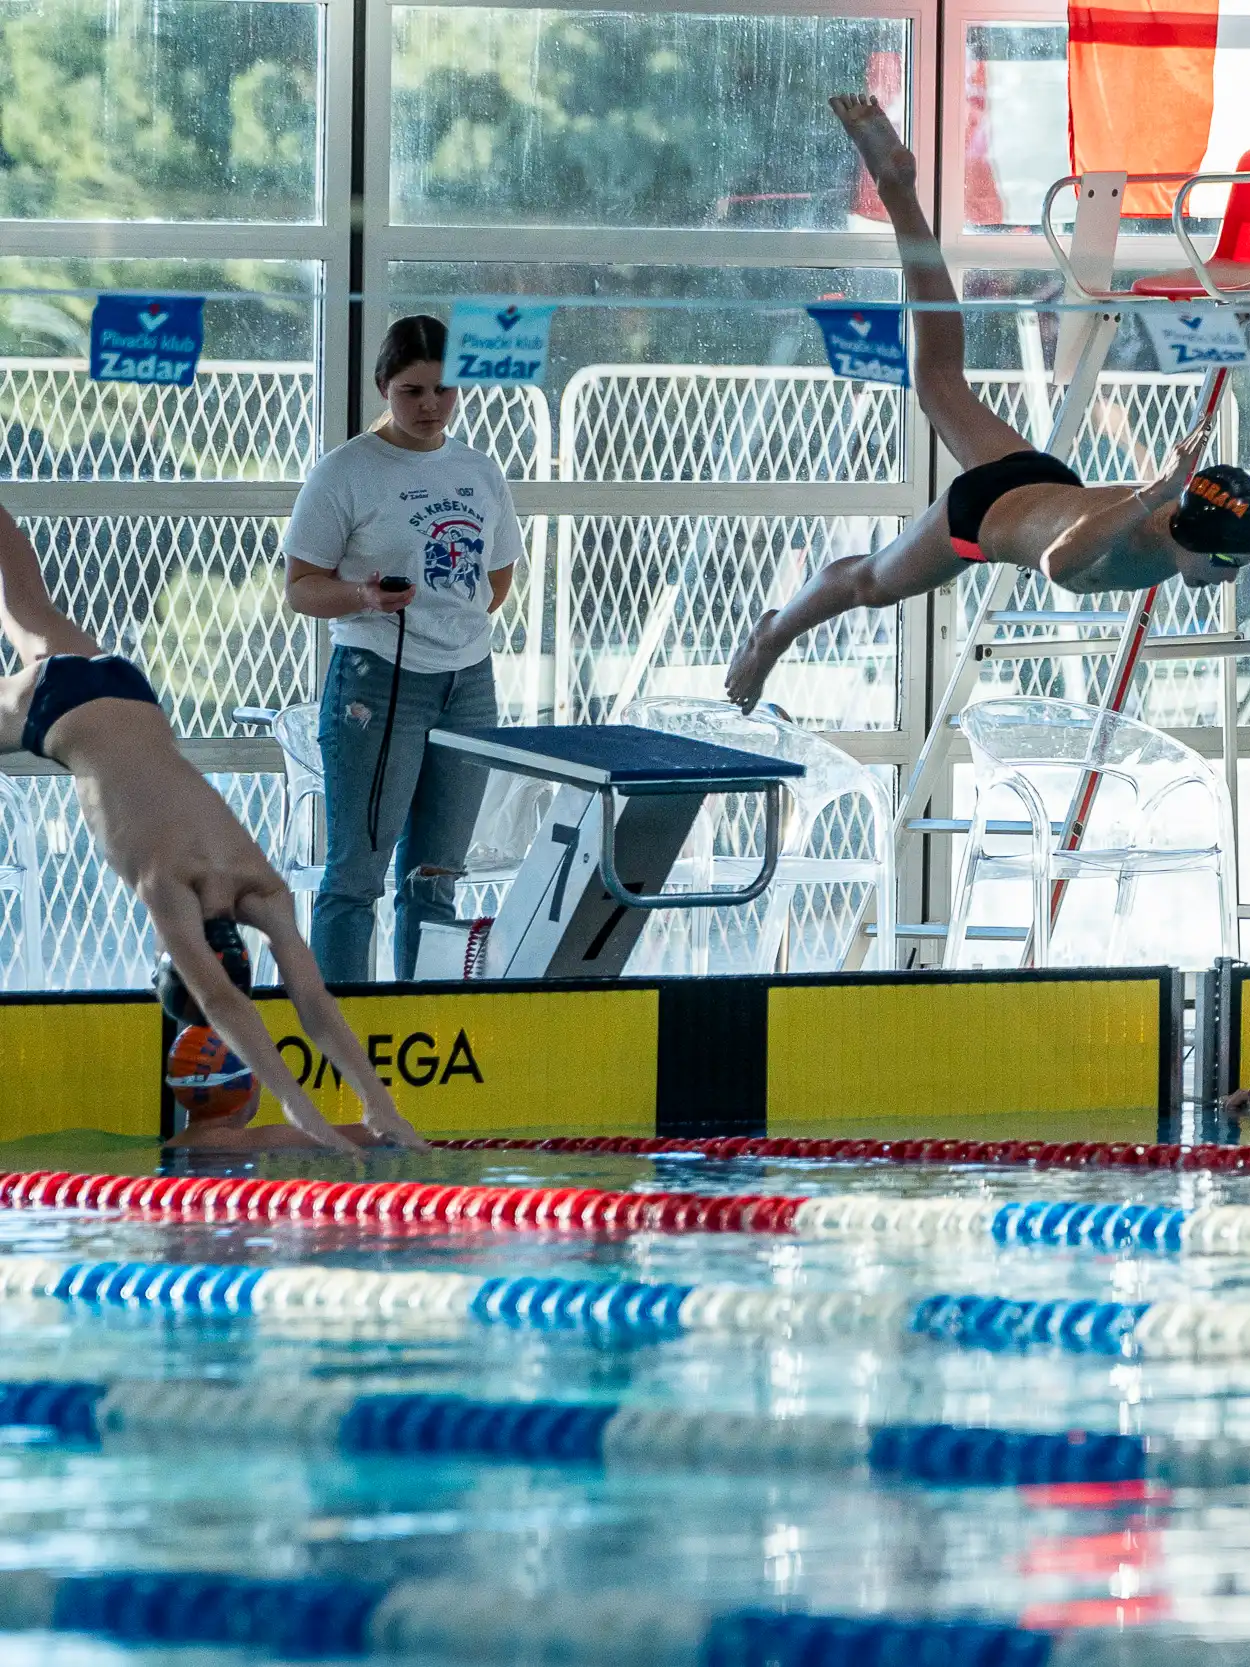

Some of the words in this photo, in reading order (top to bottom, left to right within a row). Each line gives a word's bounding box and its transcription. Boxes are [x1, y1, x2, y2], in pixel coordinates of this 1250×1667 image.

[161, 335, 195, 352] klub
[102, 353, 192, 380] Zadar
[458, 354, 540, 379] Zadar
[838, 354, 904, 383] Zadar
[409, 511, 428, 527] SV.
[424, 498, 485, 523] KRŠEVAN
[548, 822, 581, 923] 7
[582, 881, 645, 961] 7
